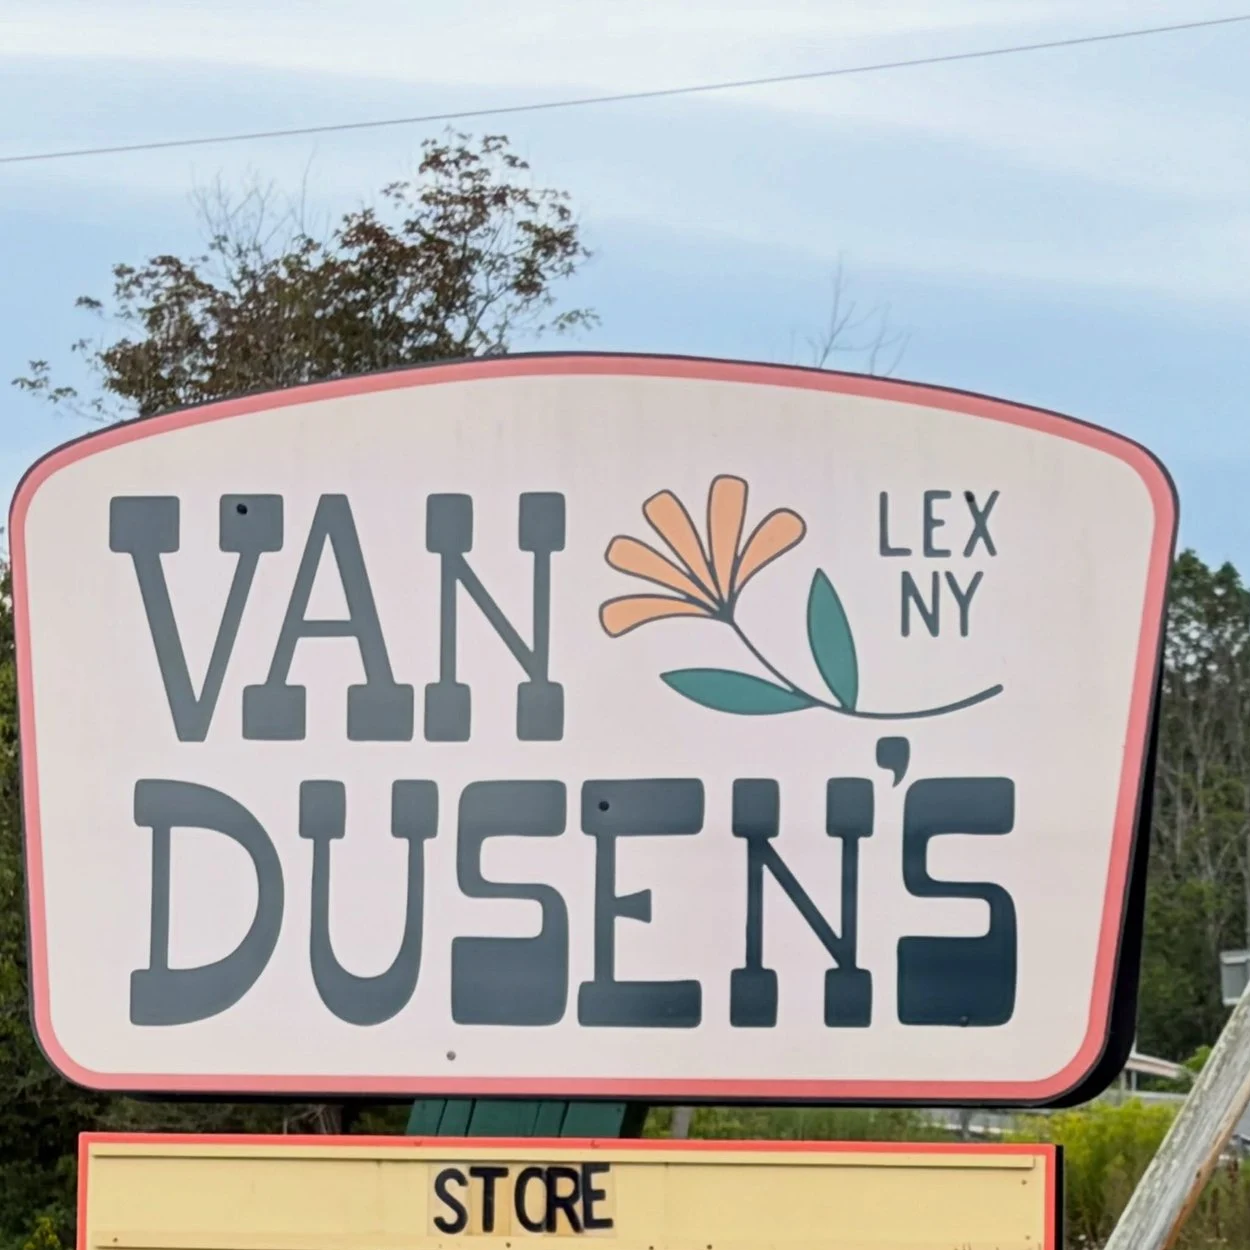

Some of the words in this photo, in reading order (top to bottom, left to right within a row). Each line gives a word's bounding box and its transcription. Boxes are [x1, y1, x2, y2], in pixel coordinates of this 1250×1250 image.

[878, 489, 998, 559] LEX
[109, 492, 567, 742] VAN
[900, 571, 983, 638] NY
[129, 736, 1017, 1028] DUSEN'S
[434, 1163, 614, 1234] STORE
